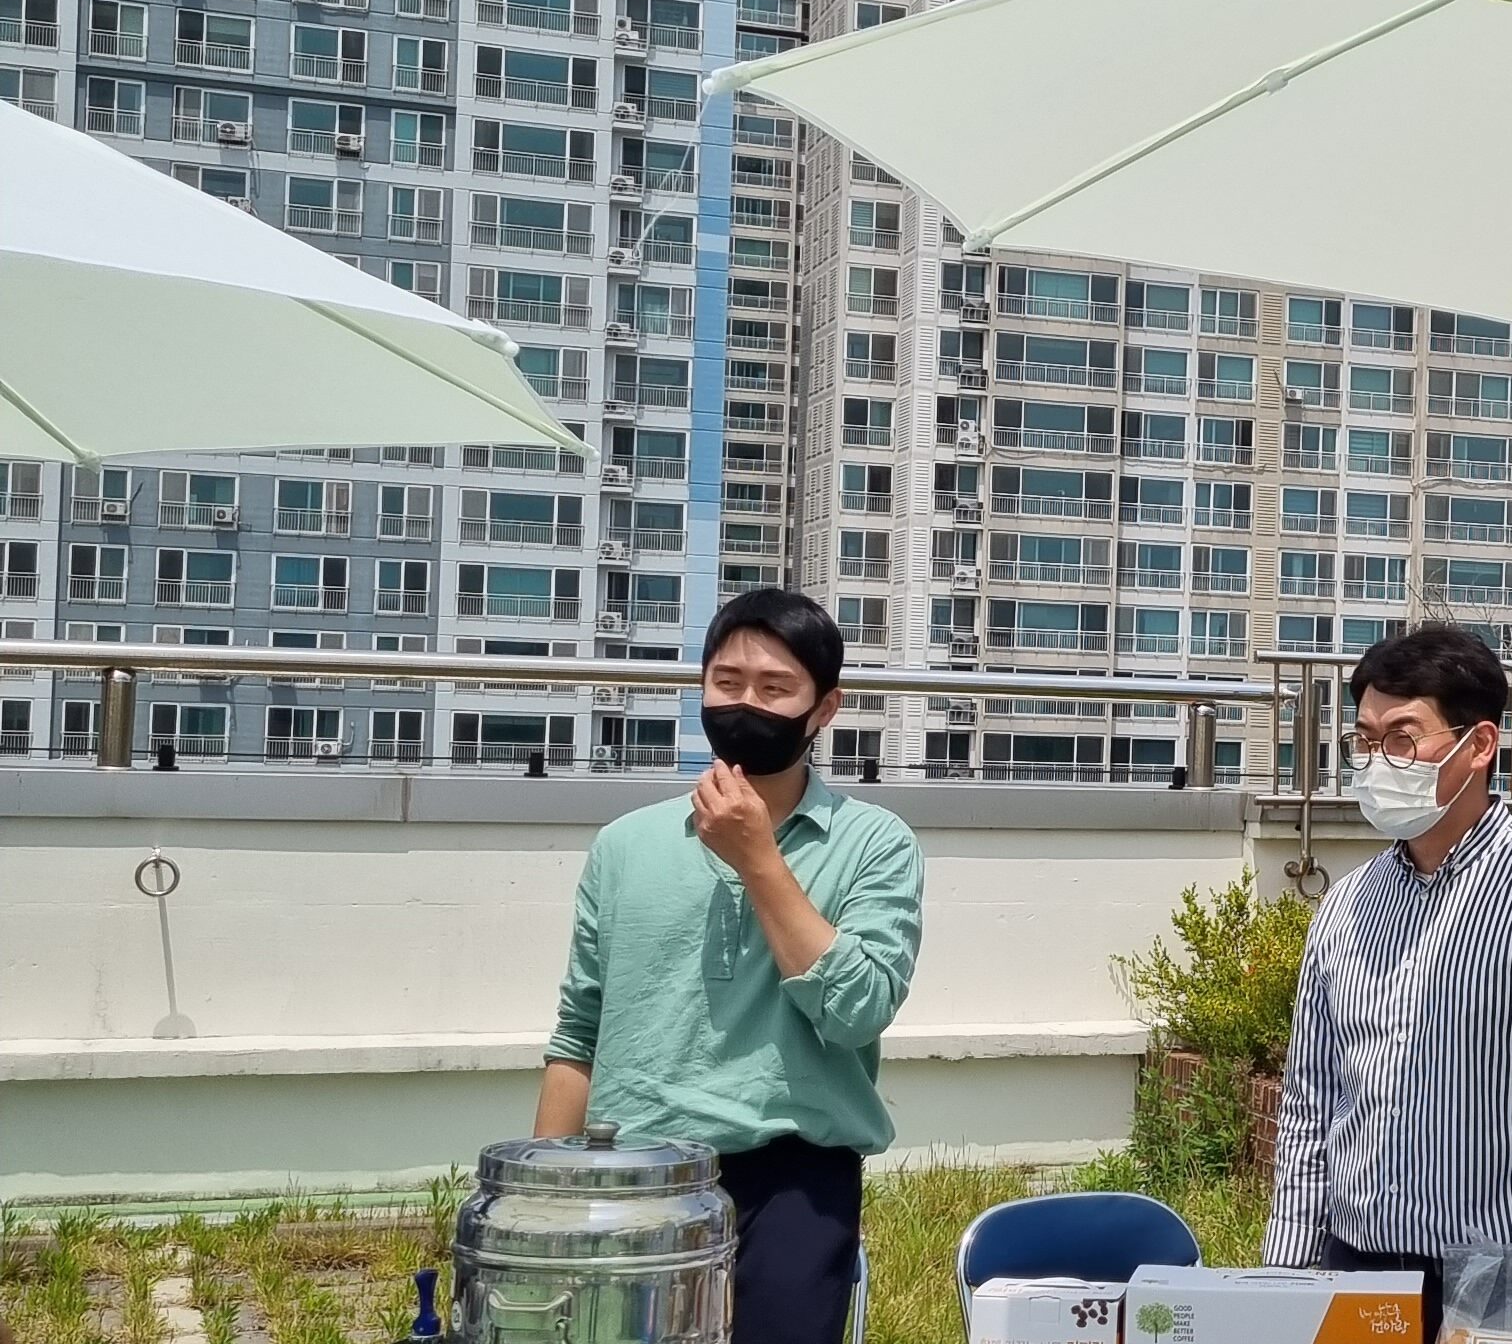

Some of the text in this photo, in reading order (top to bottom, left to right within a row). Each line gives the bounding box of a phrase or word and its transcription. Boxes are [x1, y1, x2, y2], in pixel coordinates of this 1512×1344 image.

[1173, 1304, 1193, 1312] GOOD
[1173, 1312, 1195, 1320] PEOPLE
[1172, 1334, 1195, 1342] COFFEE
